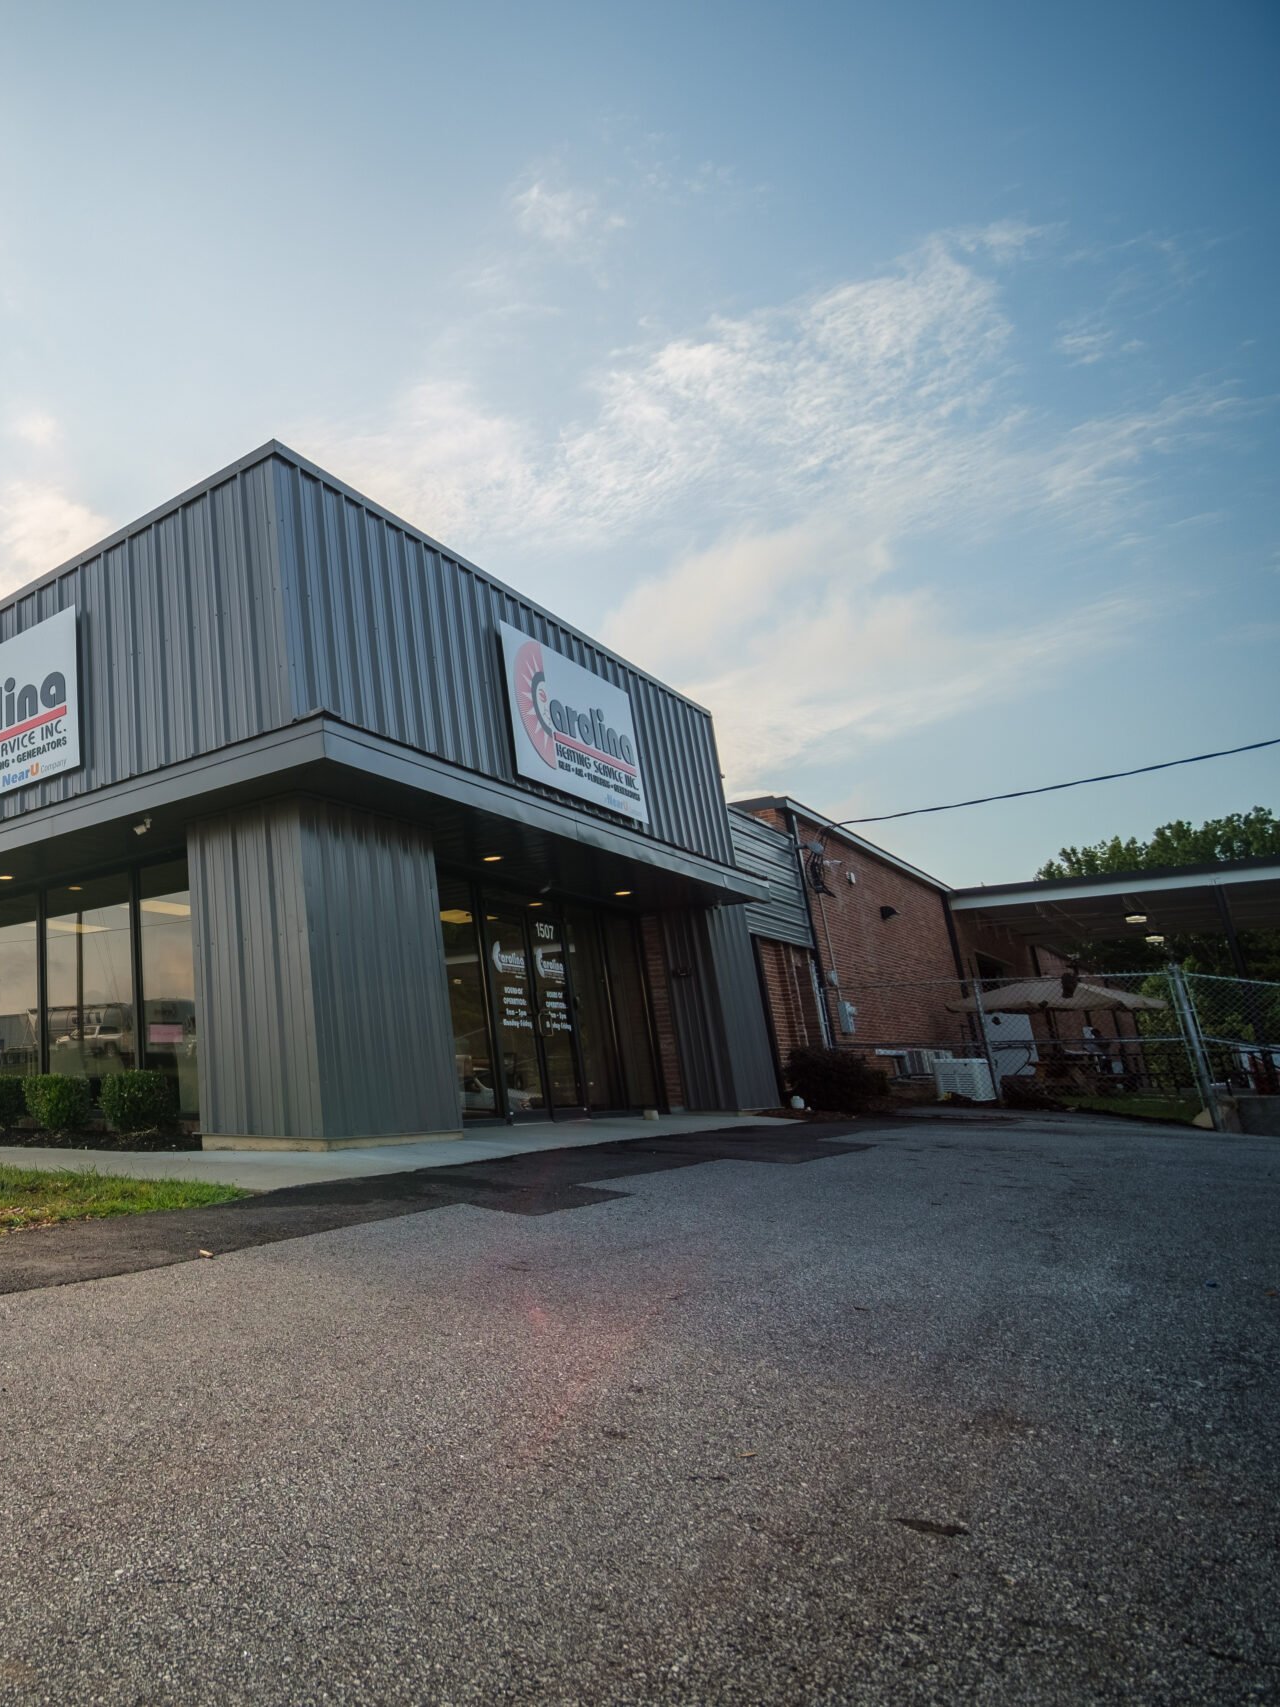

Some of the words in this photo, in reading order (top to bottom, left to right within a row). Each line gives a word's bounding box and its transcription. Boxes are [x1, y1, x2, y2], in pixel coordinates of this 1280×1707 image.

[40, 719, 67, 741] INC.
[532, 671, 636, 767] Carolina
[16, 736, 67, 763] GENERATORS
[2, 762, 40, 788] NearU
[556, 742, 592, 770] HEATING
[593, 760, 624, 785] SERVICE
[624, 773, 639, 791] INC.
[535, 921, 554, 940] 1507
